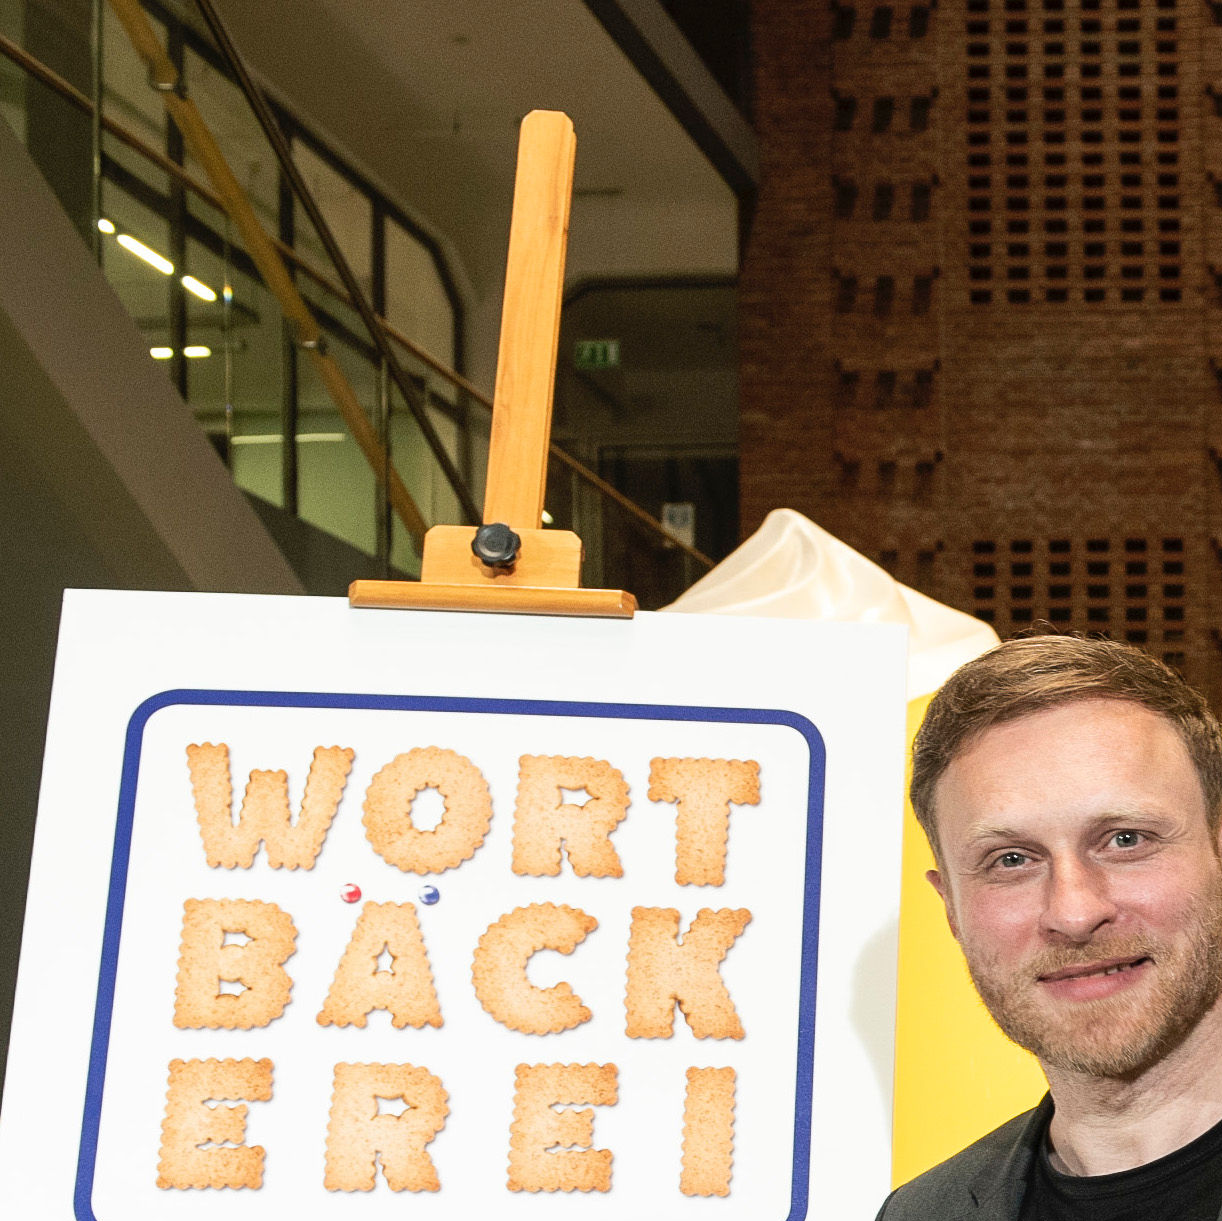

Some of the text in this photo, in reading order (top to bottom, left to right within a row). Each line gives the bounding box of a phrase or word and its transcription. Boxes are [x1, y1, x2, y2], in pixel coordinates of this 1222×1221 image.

[186, 742, 761, 888] WORT
[172, 882, 752, 1041] BÄCK
[156, 1057, 736, 1198] EREI
